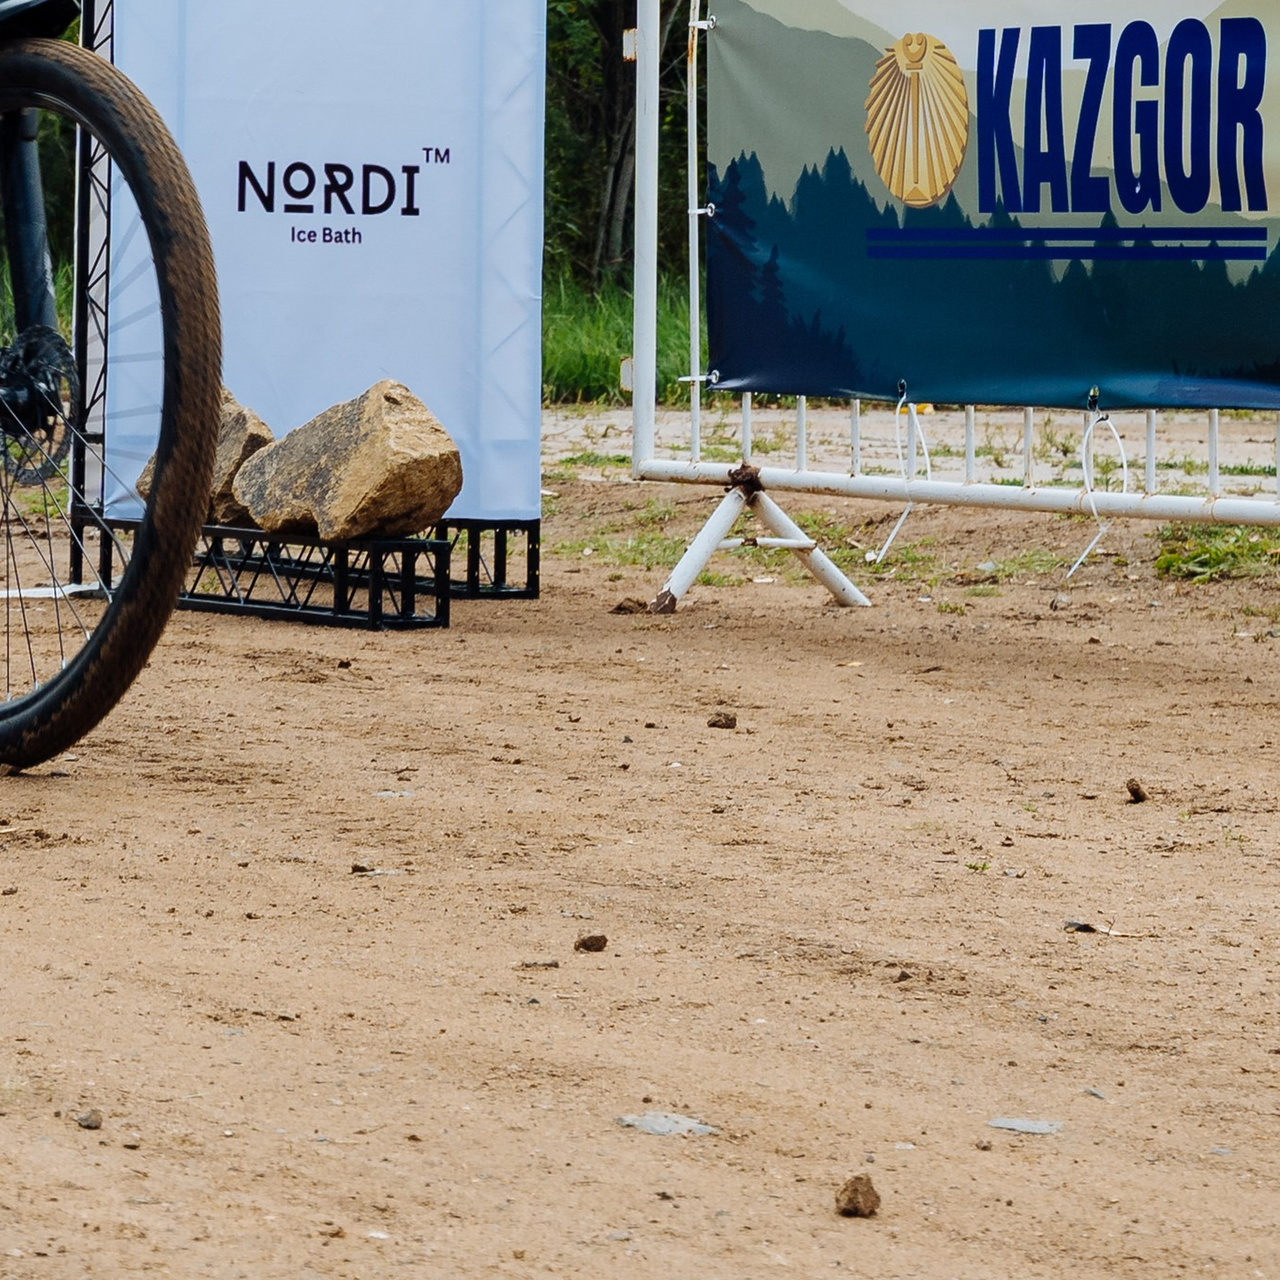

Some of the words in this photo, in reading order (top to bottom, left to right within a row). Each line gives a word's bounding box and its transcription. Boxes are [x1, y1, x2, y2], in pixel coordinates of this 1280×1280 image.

[977, 17, 1267, 214] KAZGOR
[291, 226, 318, 243] Ice
[322, 226, 362, 244] Bath
